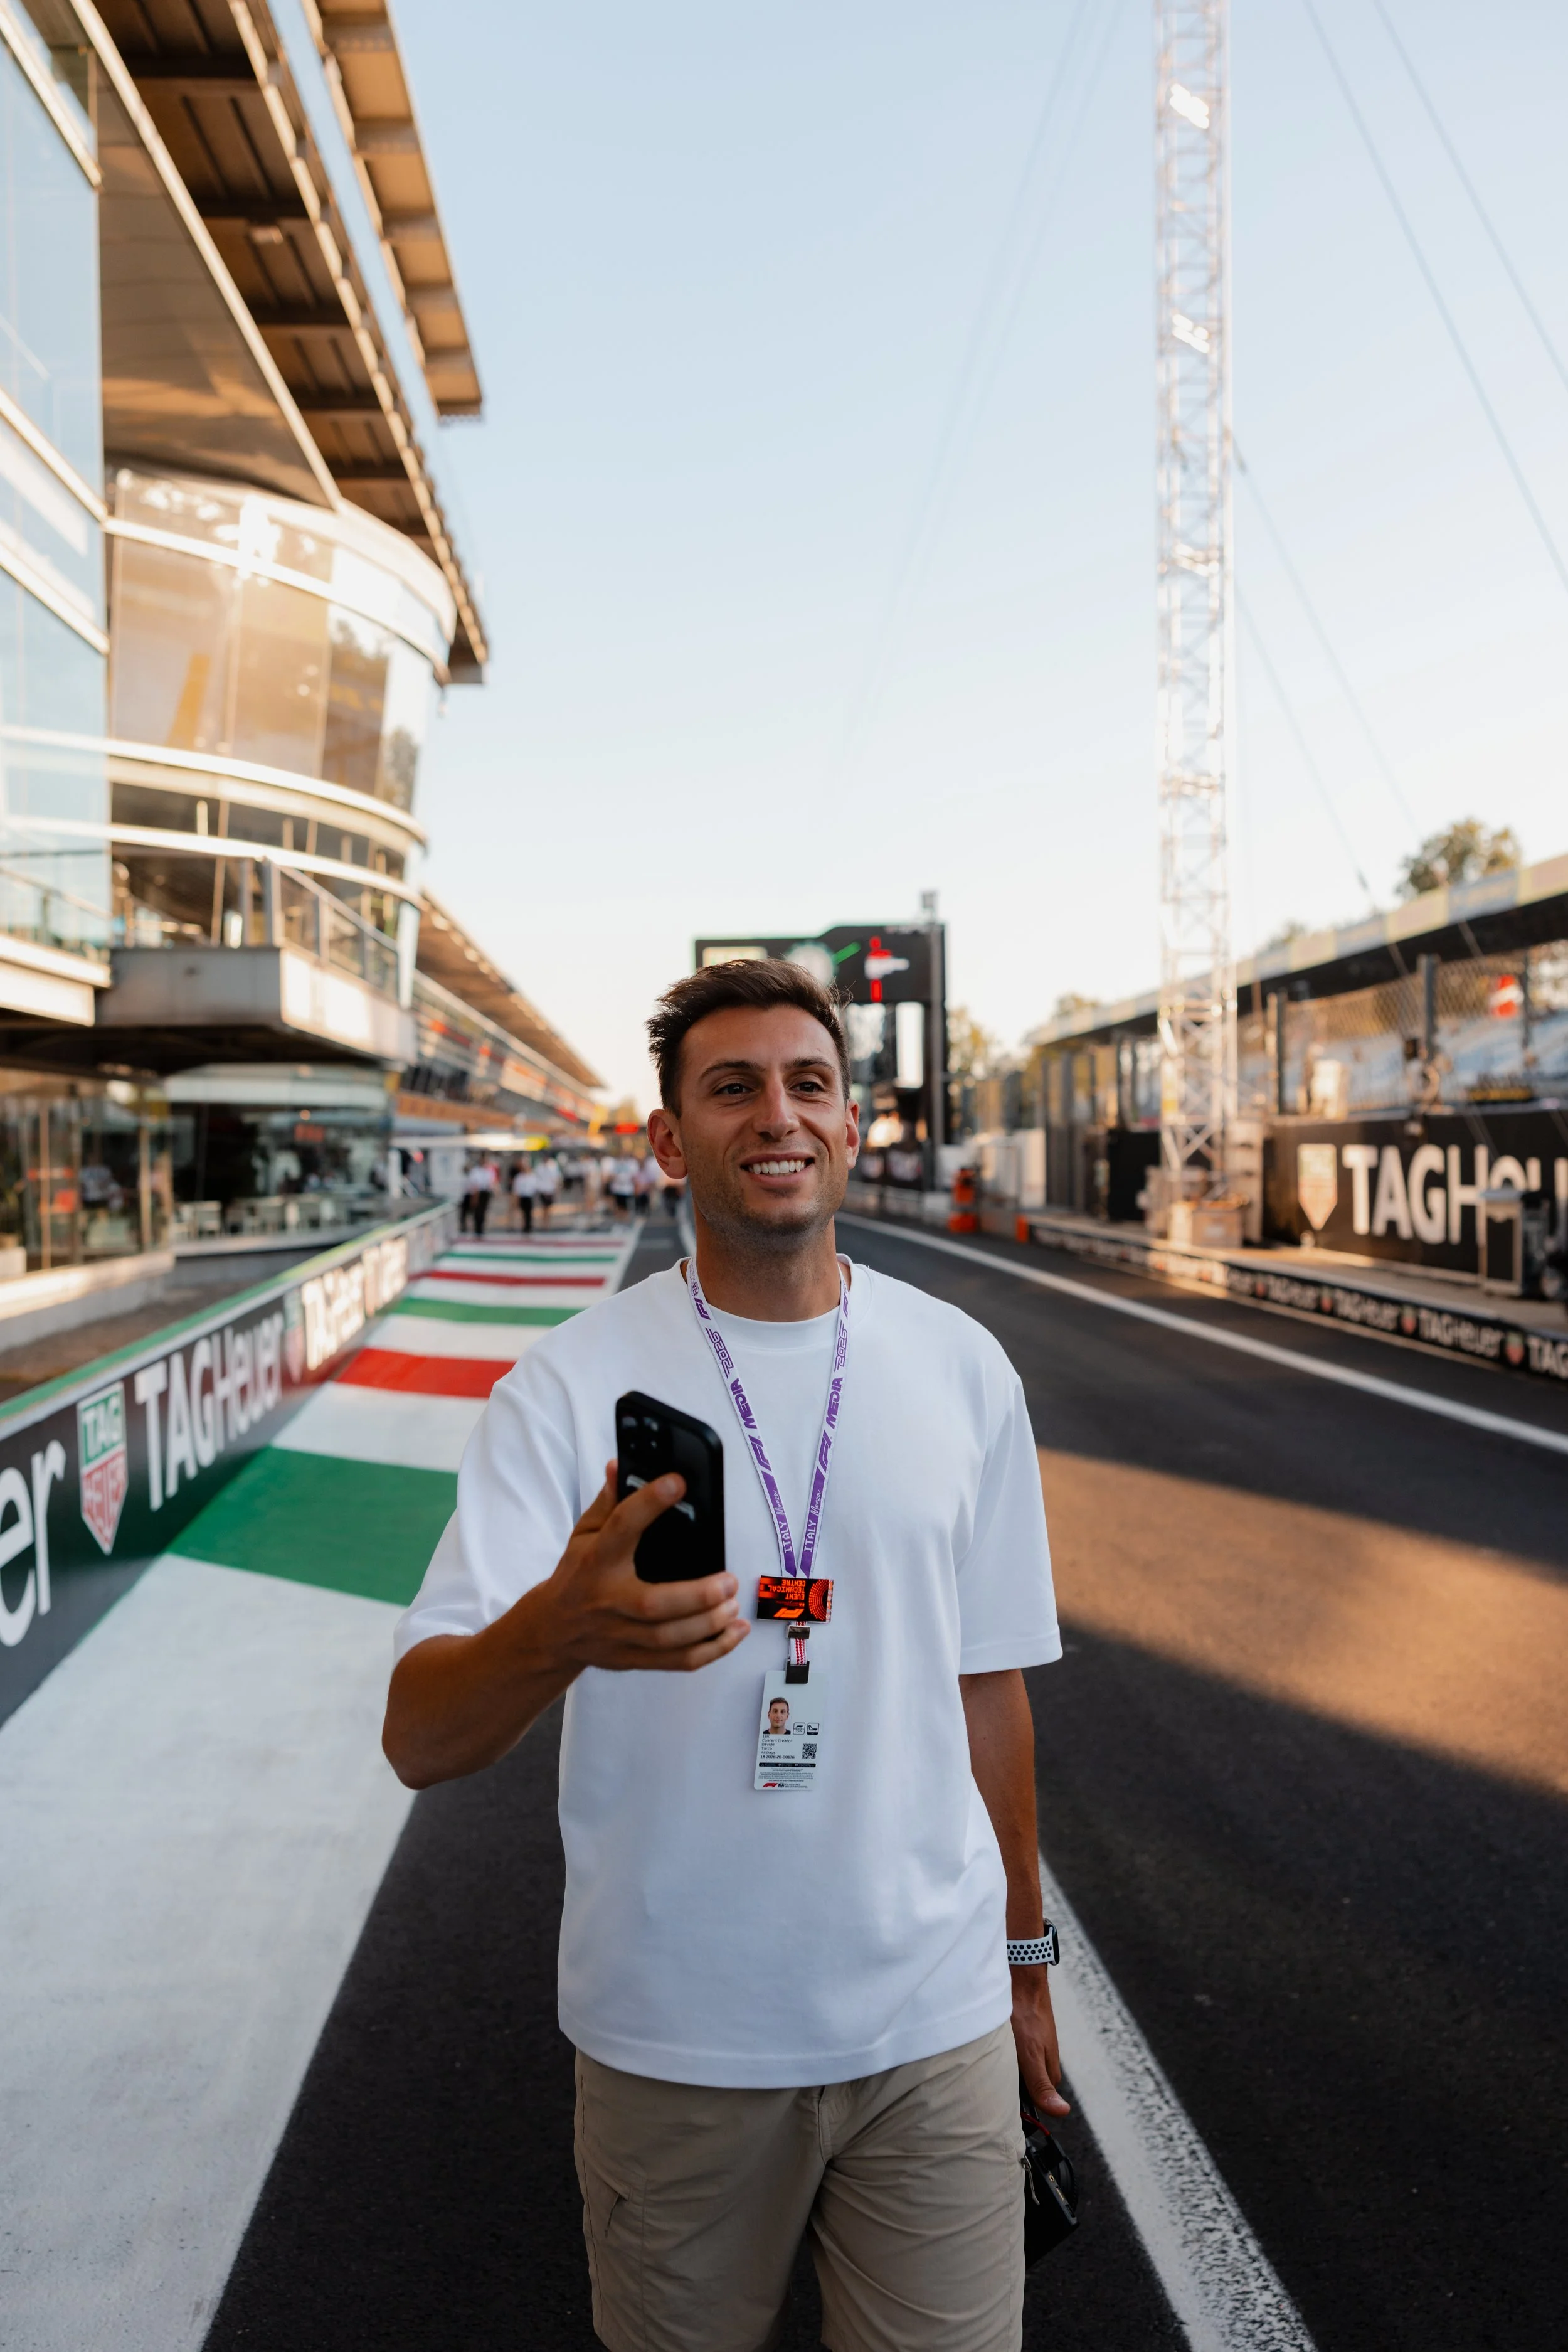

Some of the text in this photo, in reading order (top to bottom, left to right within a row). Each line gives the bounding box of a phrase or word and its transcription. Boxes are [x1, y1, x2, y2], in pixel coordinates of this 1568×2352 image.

[694, 1297, 711, 1320] F1
[705, 1327, 734, 1379] 2026
[834, 1319, 847, 1372] 2026
[730, 1378, 757, 1429] MEDIA
[826, 1377, 843, 1430] MEDIA
[81, 1395, 123, 1459] TAG
[748, 1435, 772, 1472] F1
[818, 1430, 832, 1473] F1
[773, 1489, 785, 1515] Monza
[810, 1489, 821, 1516] Monza
[779, 1521, 792, 1553] ITALY
[804, 1520, 817, 1553] ITALY
